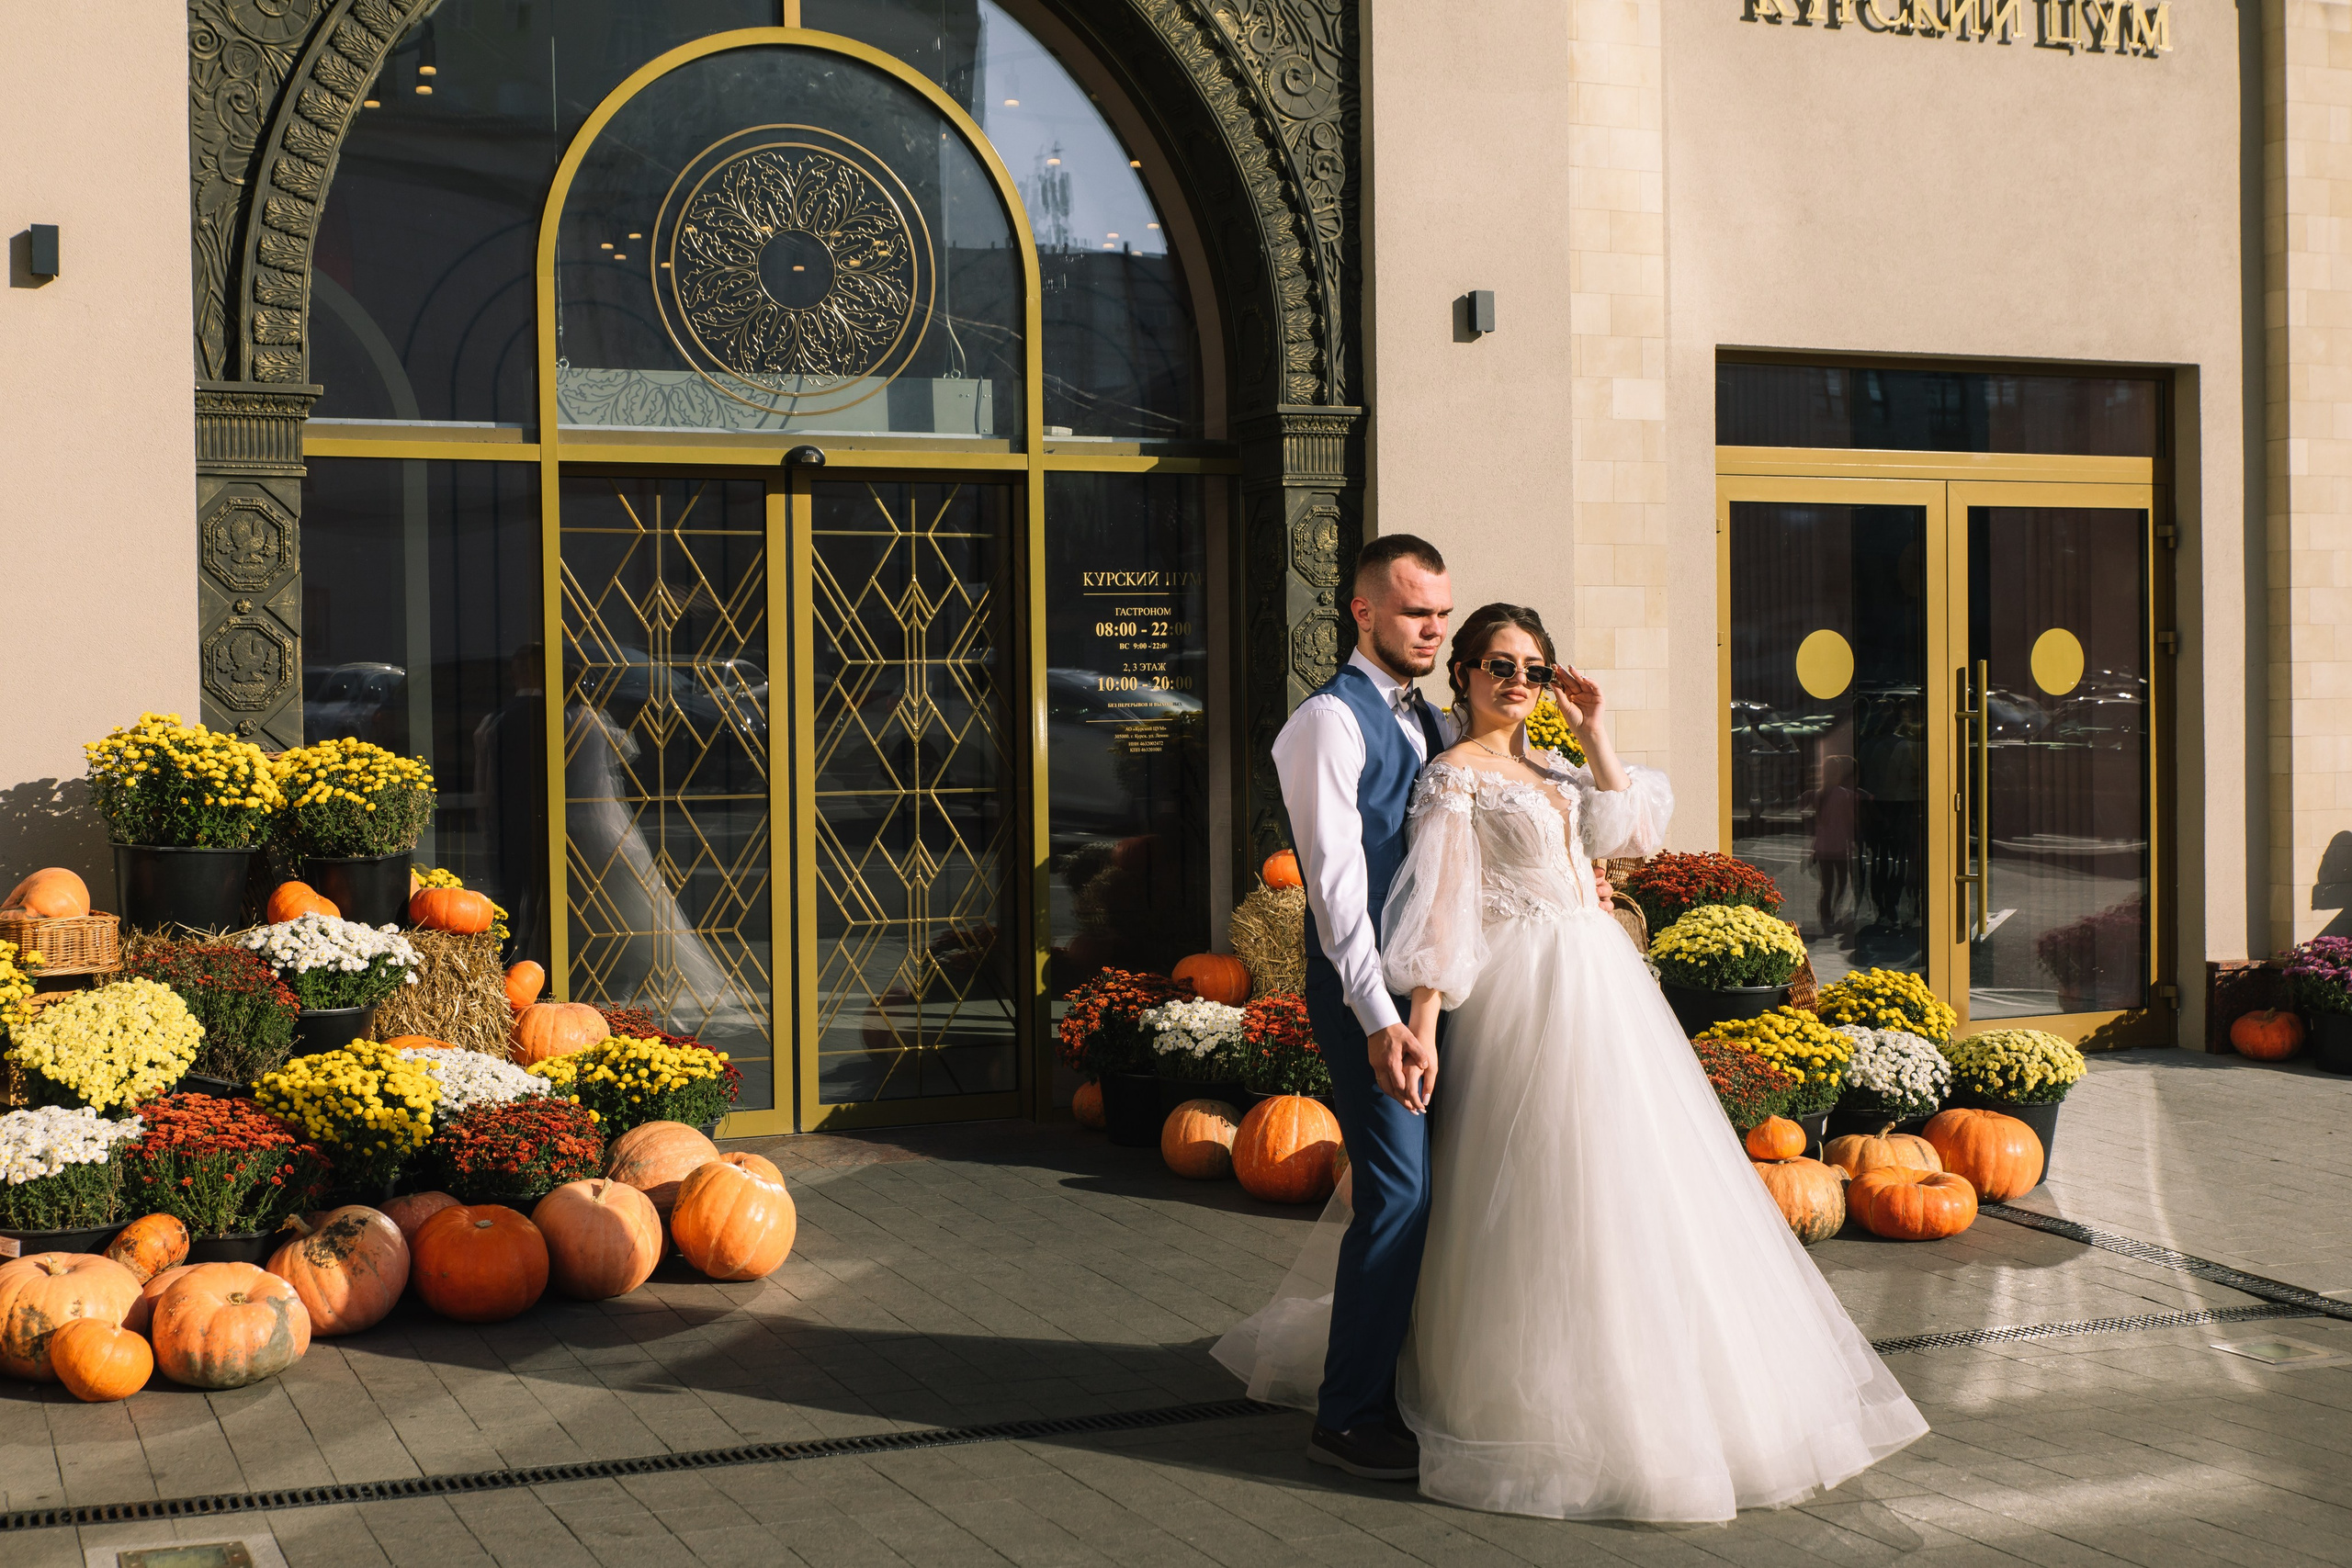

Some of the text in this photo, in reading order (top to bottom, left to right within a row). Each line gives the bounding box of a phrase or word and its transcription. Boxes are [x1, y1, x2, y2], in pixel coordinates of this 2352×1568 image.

[2046, 0, 2174, 52] ЦУМ
[1083, 570, 1159, 587] КУРСКИЙ
[1114, 607, 1171, 616] ГАСТРОНОМ
[1095, 622, 1137, 637] 08:00
[1150, 621, 1192, 637] 22:00
[1123, 662, 1167, 672] 2, 3 ЭТАЖ
[1097, 676, 1138, 692] 10:00
[1152, 675, 1193, 691] 20:00
